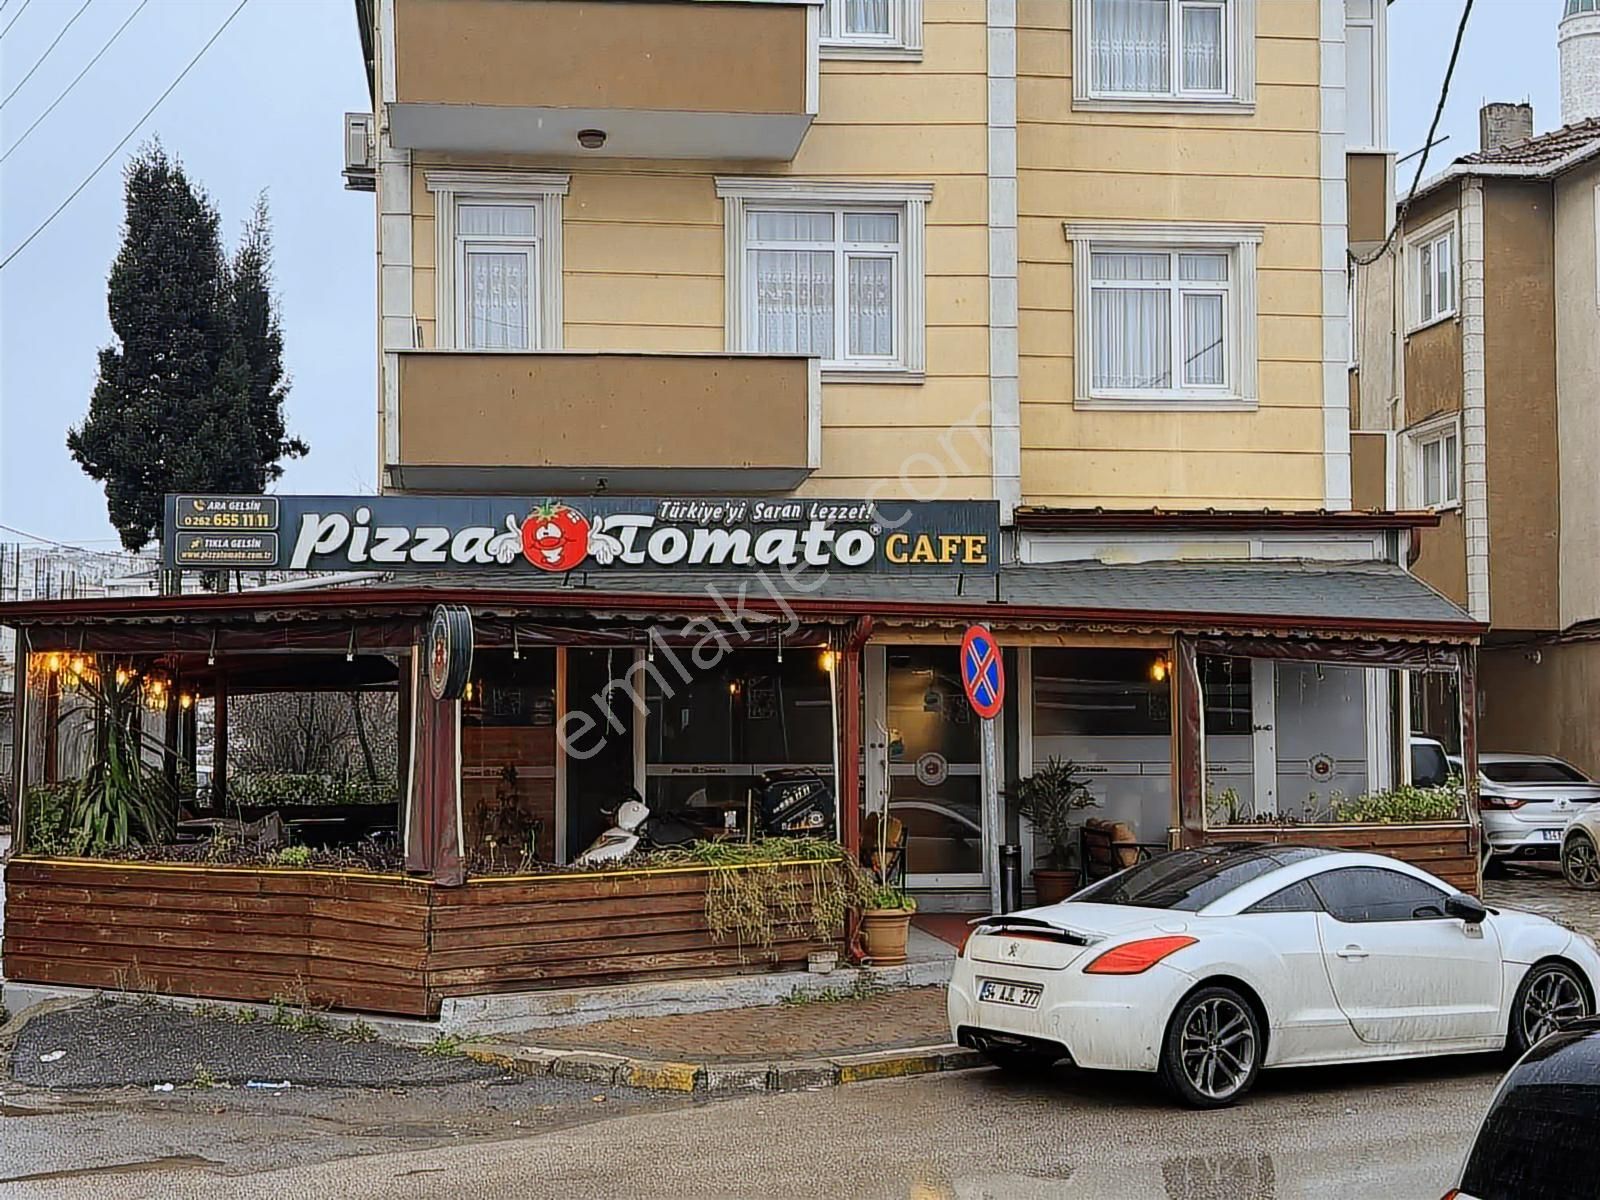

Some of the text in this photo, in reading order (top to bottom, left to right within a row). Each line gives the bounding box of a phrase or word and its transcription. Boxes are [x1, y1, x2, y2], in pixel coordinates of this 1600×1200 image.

[207, 501, 226, 511] ARA
[659, 501, 747, 524] Türkiye'yi
[753, 502, 801, 520] Saran
[213, 513, 240, 527] 655
[204, 538, 229, 548] TIKLA
[289, 507, 988, 569] Pizza Tomato CAFE
[1019, 988, 1041, 1006] 377
